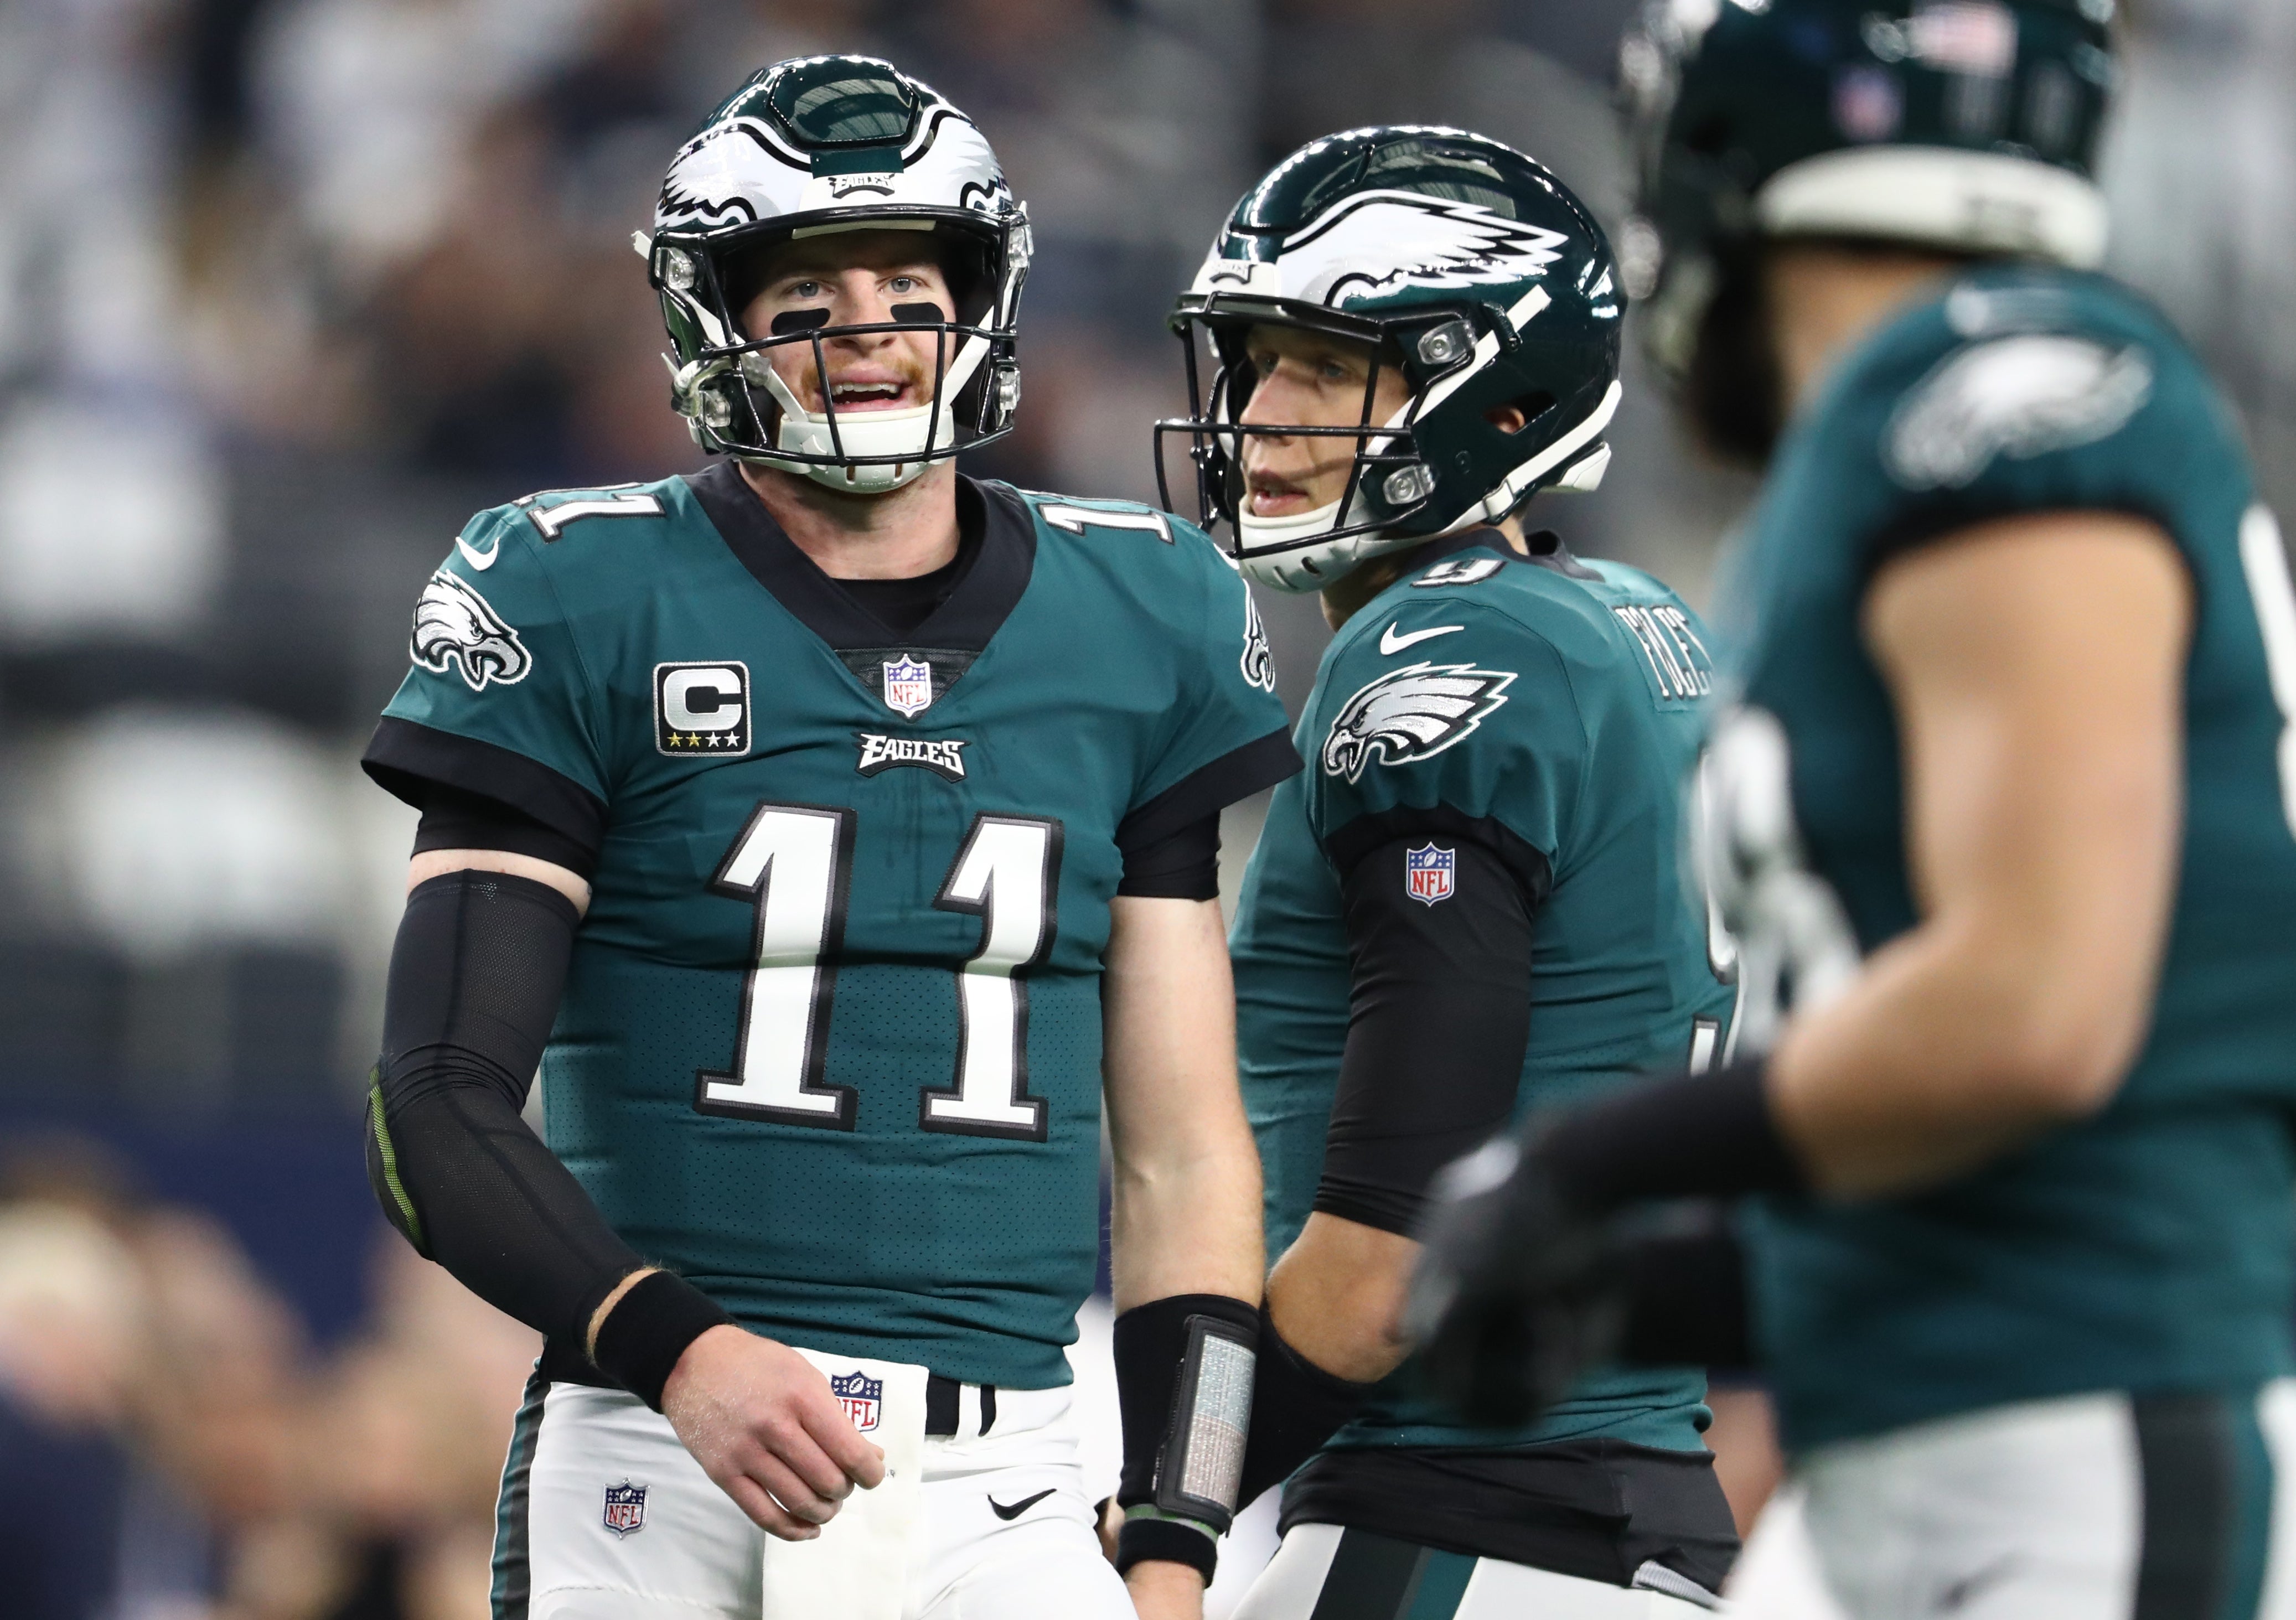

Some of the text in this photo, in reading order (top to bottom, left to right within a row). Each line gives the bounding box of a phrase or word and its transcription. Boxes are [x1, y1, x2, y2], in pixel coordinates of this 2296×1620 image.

[663, 668, 742, 732] C
[892, 684, 924, 706] NFL
[859, 733, 965, 776] EAGLES
[1411, 870, 1448, 897] NFL
[694, 800, 1064, 1141] 11
[608, 1504, 639, 1527] NFL
